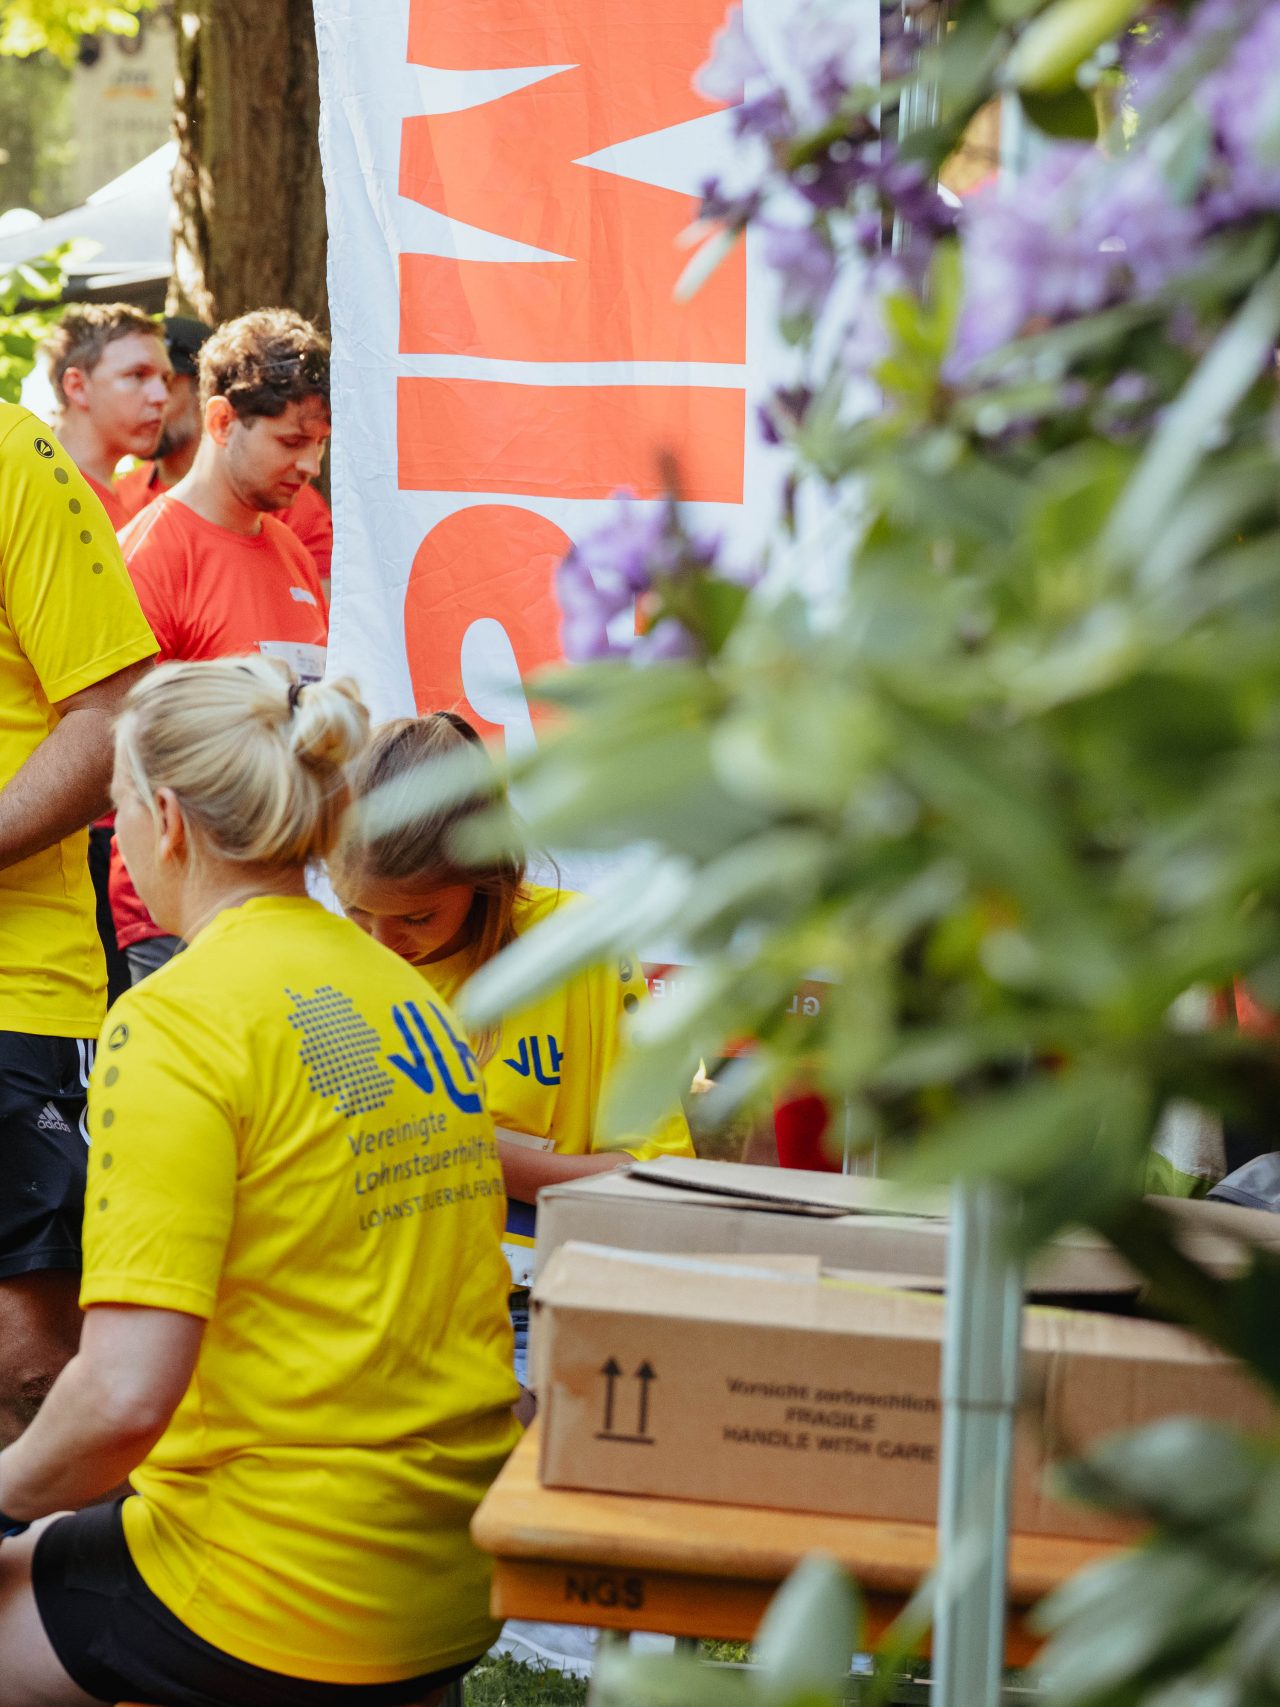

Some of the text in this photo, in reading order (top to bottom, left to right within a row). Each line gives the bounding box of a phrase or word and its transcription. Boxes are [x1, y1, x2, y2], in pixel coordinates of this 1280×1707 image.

[348, 1111, 448, 1157] Vereinigte
[726, 1377, 810, 1400] Vorsicht
[784, 1406, 877, 1432] FRAGILE
[723, 1425, 938, 1464] HANDLE WITH CARE
[564, 1576, 646, 1611] NGS
